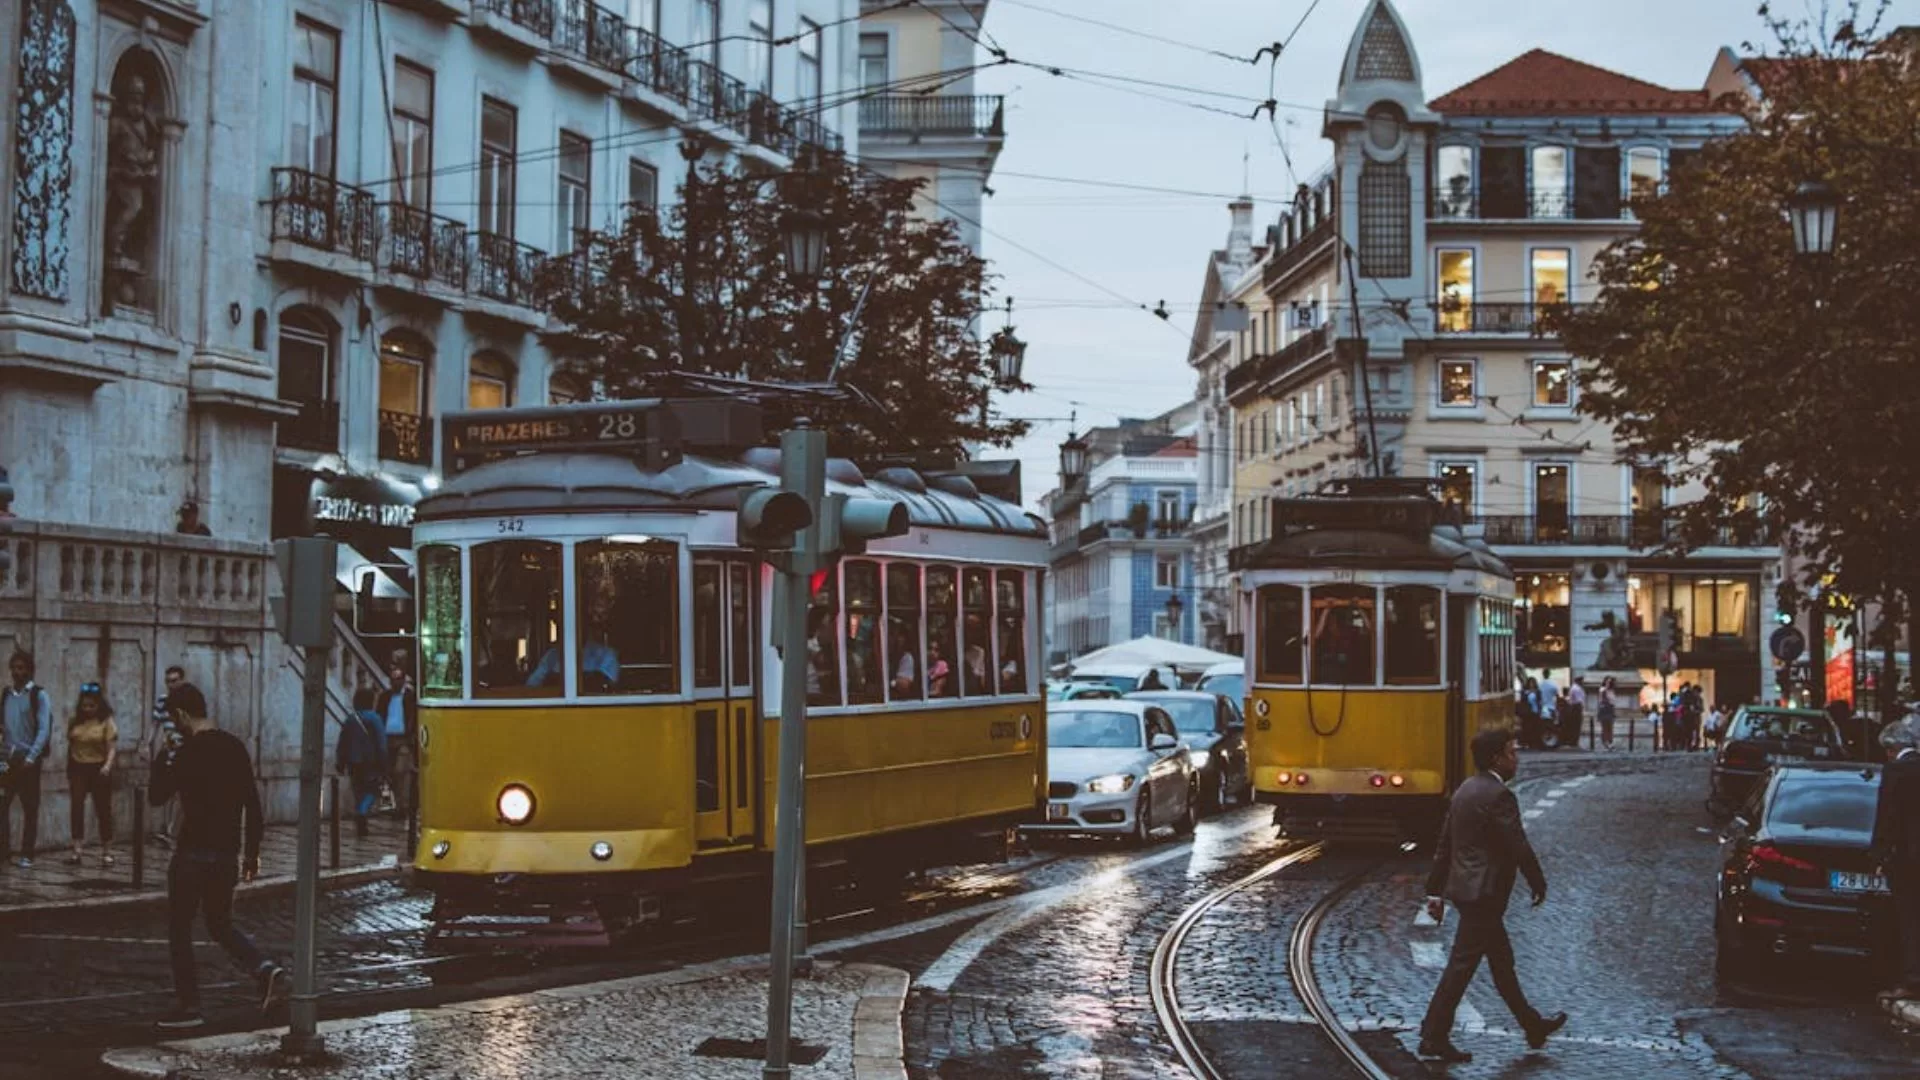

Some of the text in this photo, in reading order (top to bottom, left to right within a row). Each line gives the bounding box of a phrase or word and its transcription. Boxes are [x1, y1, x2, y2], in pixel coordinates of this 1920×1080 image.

[467, 413, 637, 442] PRAZERES 28
[498, 519, 524, 534] 542
